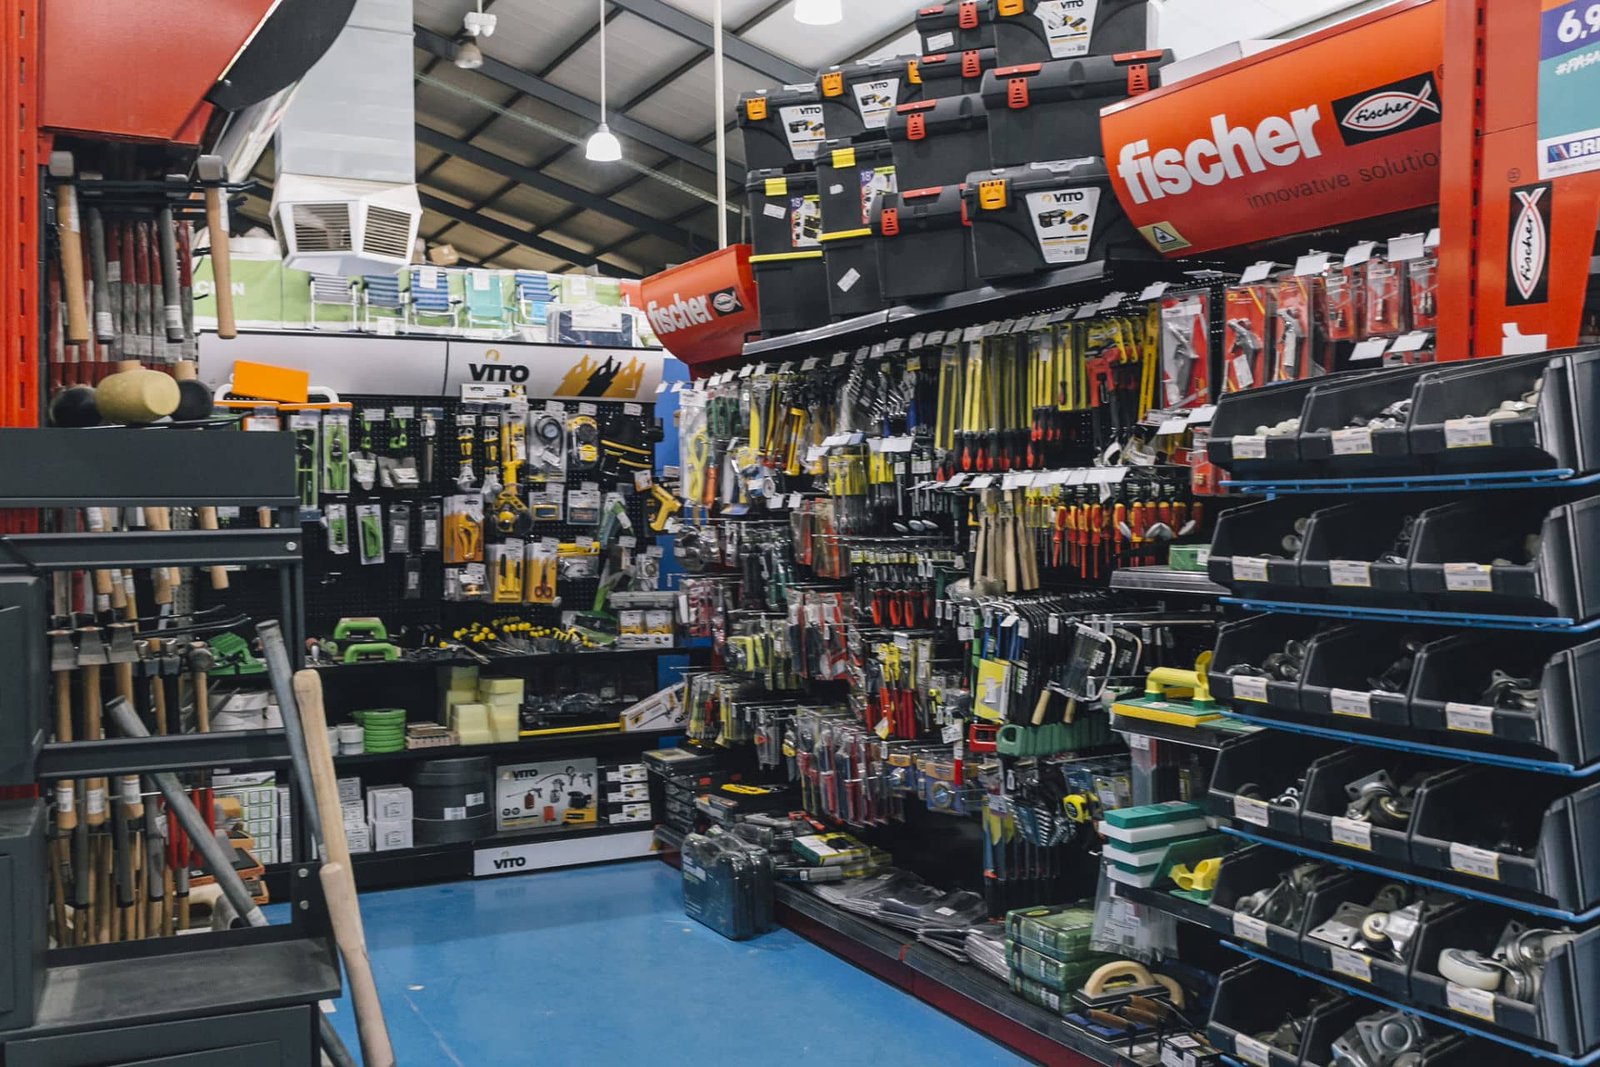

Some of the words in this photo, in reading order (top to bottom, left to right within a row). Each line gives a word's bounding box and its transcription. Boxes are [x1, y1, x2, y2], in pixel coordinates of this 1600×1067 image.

[800, 107, 822, 115] VITO
[1355, 101, 1412, 124] fischer
[1117, 104, 1322, 205] fischer
[1247, 172, 1351, 210] innovative
[1358, 150, 1440, 184] solutio
[1053, 192, 1084, 203] VITO
[1519, 214, 1534, 282] fischer
[647, 292, 714, 335] fischer
[468, 363, 530, 383] VITO
[512, 769, 539, 779] VITO
[493, 857, 527, 870] VITO
